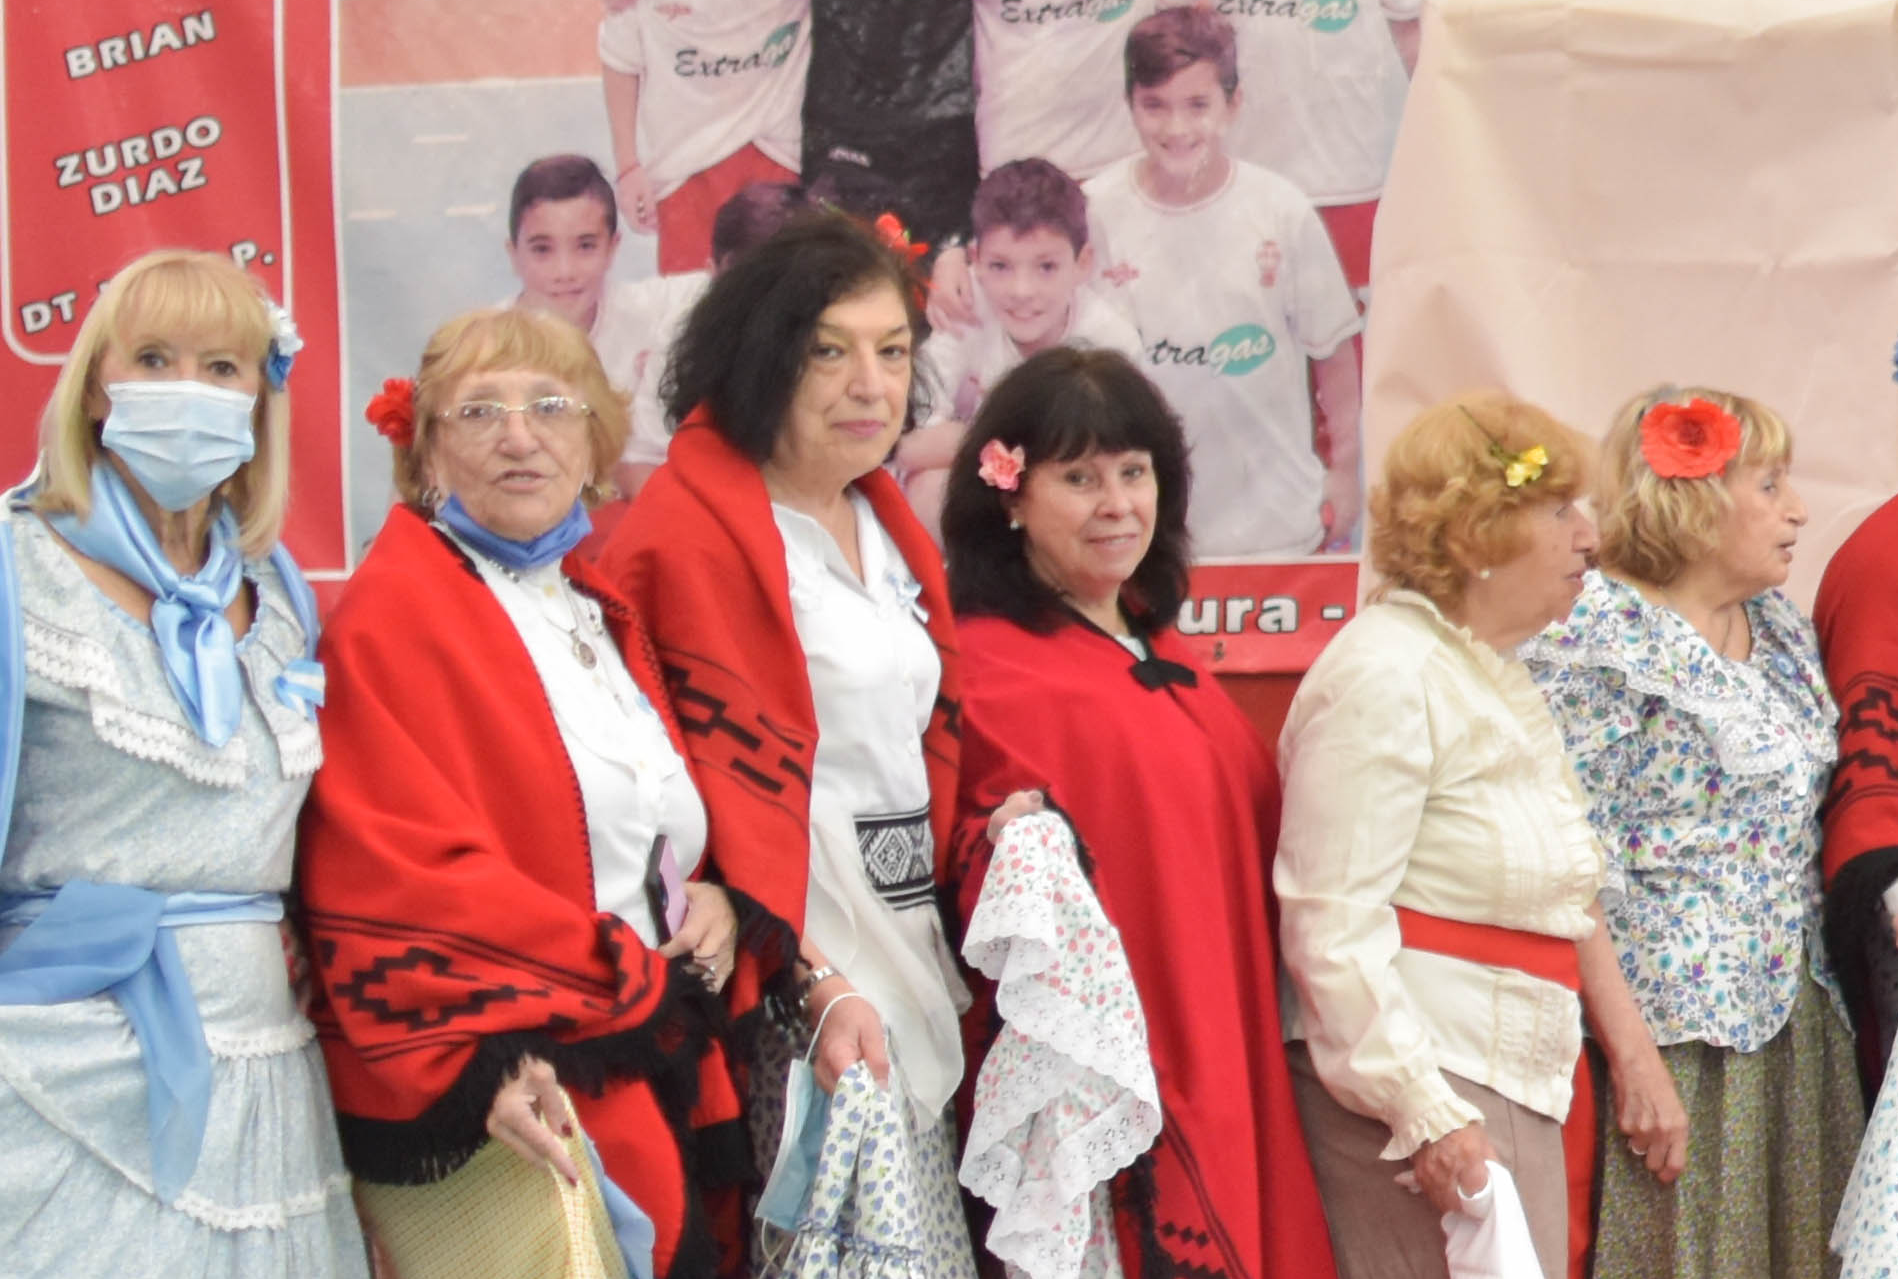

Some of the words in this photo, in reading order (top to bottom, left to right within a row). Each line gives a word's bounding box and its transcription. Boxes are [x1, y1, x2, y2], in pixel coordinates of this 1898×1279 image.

[64, 10, 217, 79] BRIAN
[55, 115, 222, 188] ZURDO
[90, 156, 208, 216] DIAZ
[20, 291, 78, 335] DT
[1148, 327, 1274, 376] tragas
